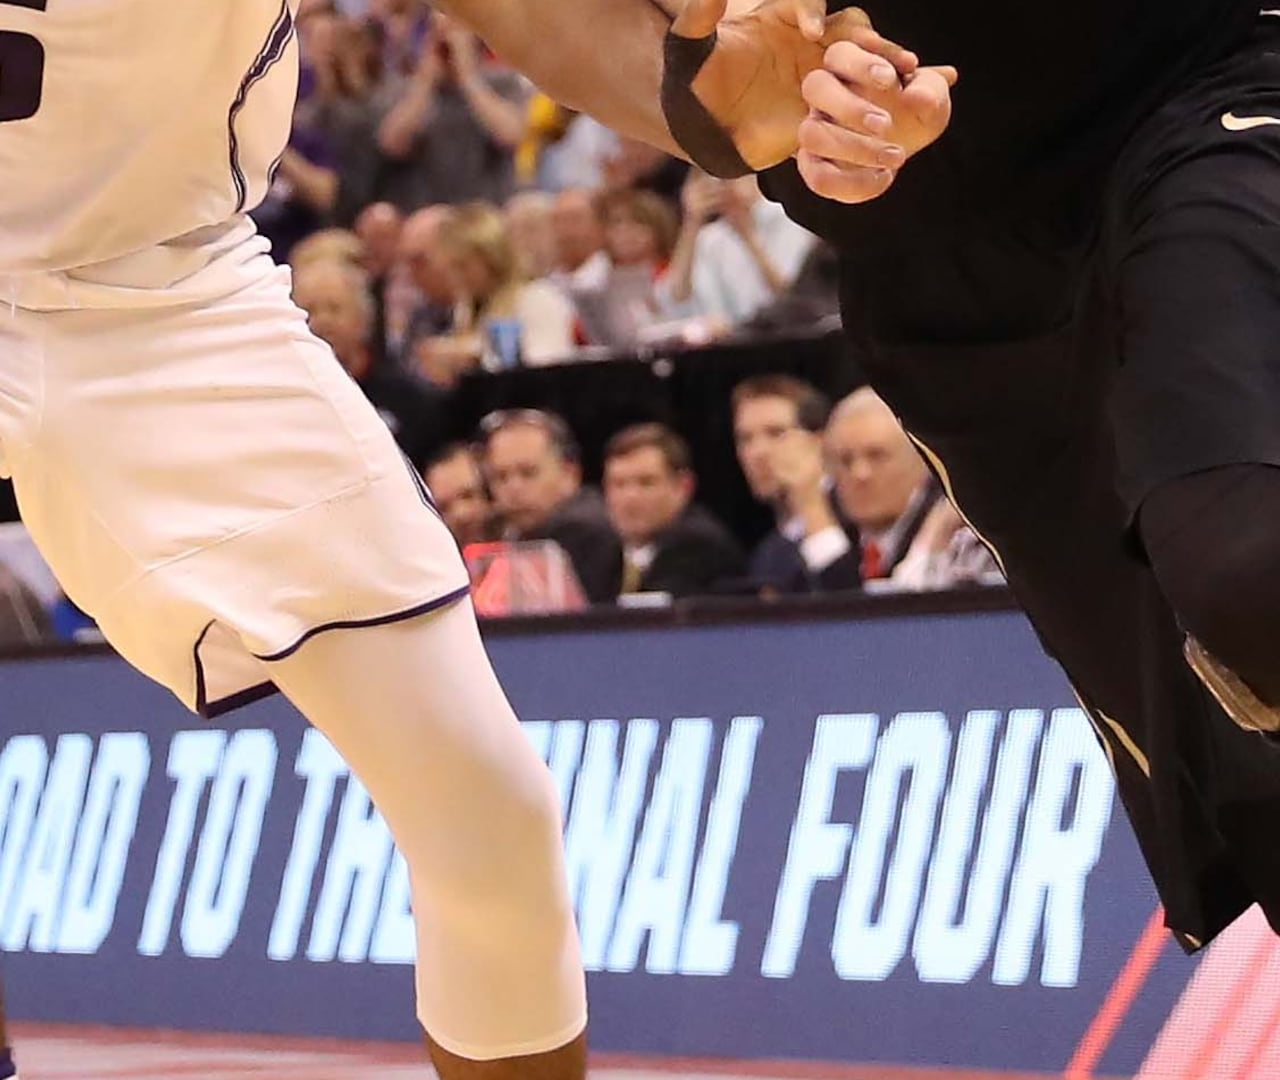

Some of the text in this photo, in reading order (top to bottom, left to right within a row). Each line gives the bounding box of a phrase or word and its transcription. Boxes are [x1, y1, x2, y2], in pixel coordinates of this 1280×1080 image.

[137, 727, 279, 959] TO
[519, 716, 764, 976] NAL
[760, 707, 1116, 988] FOUR
